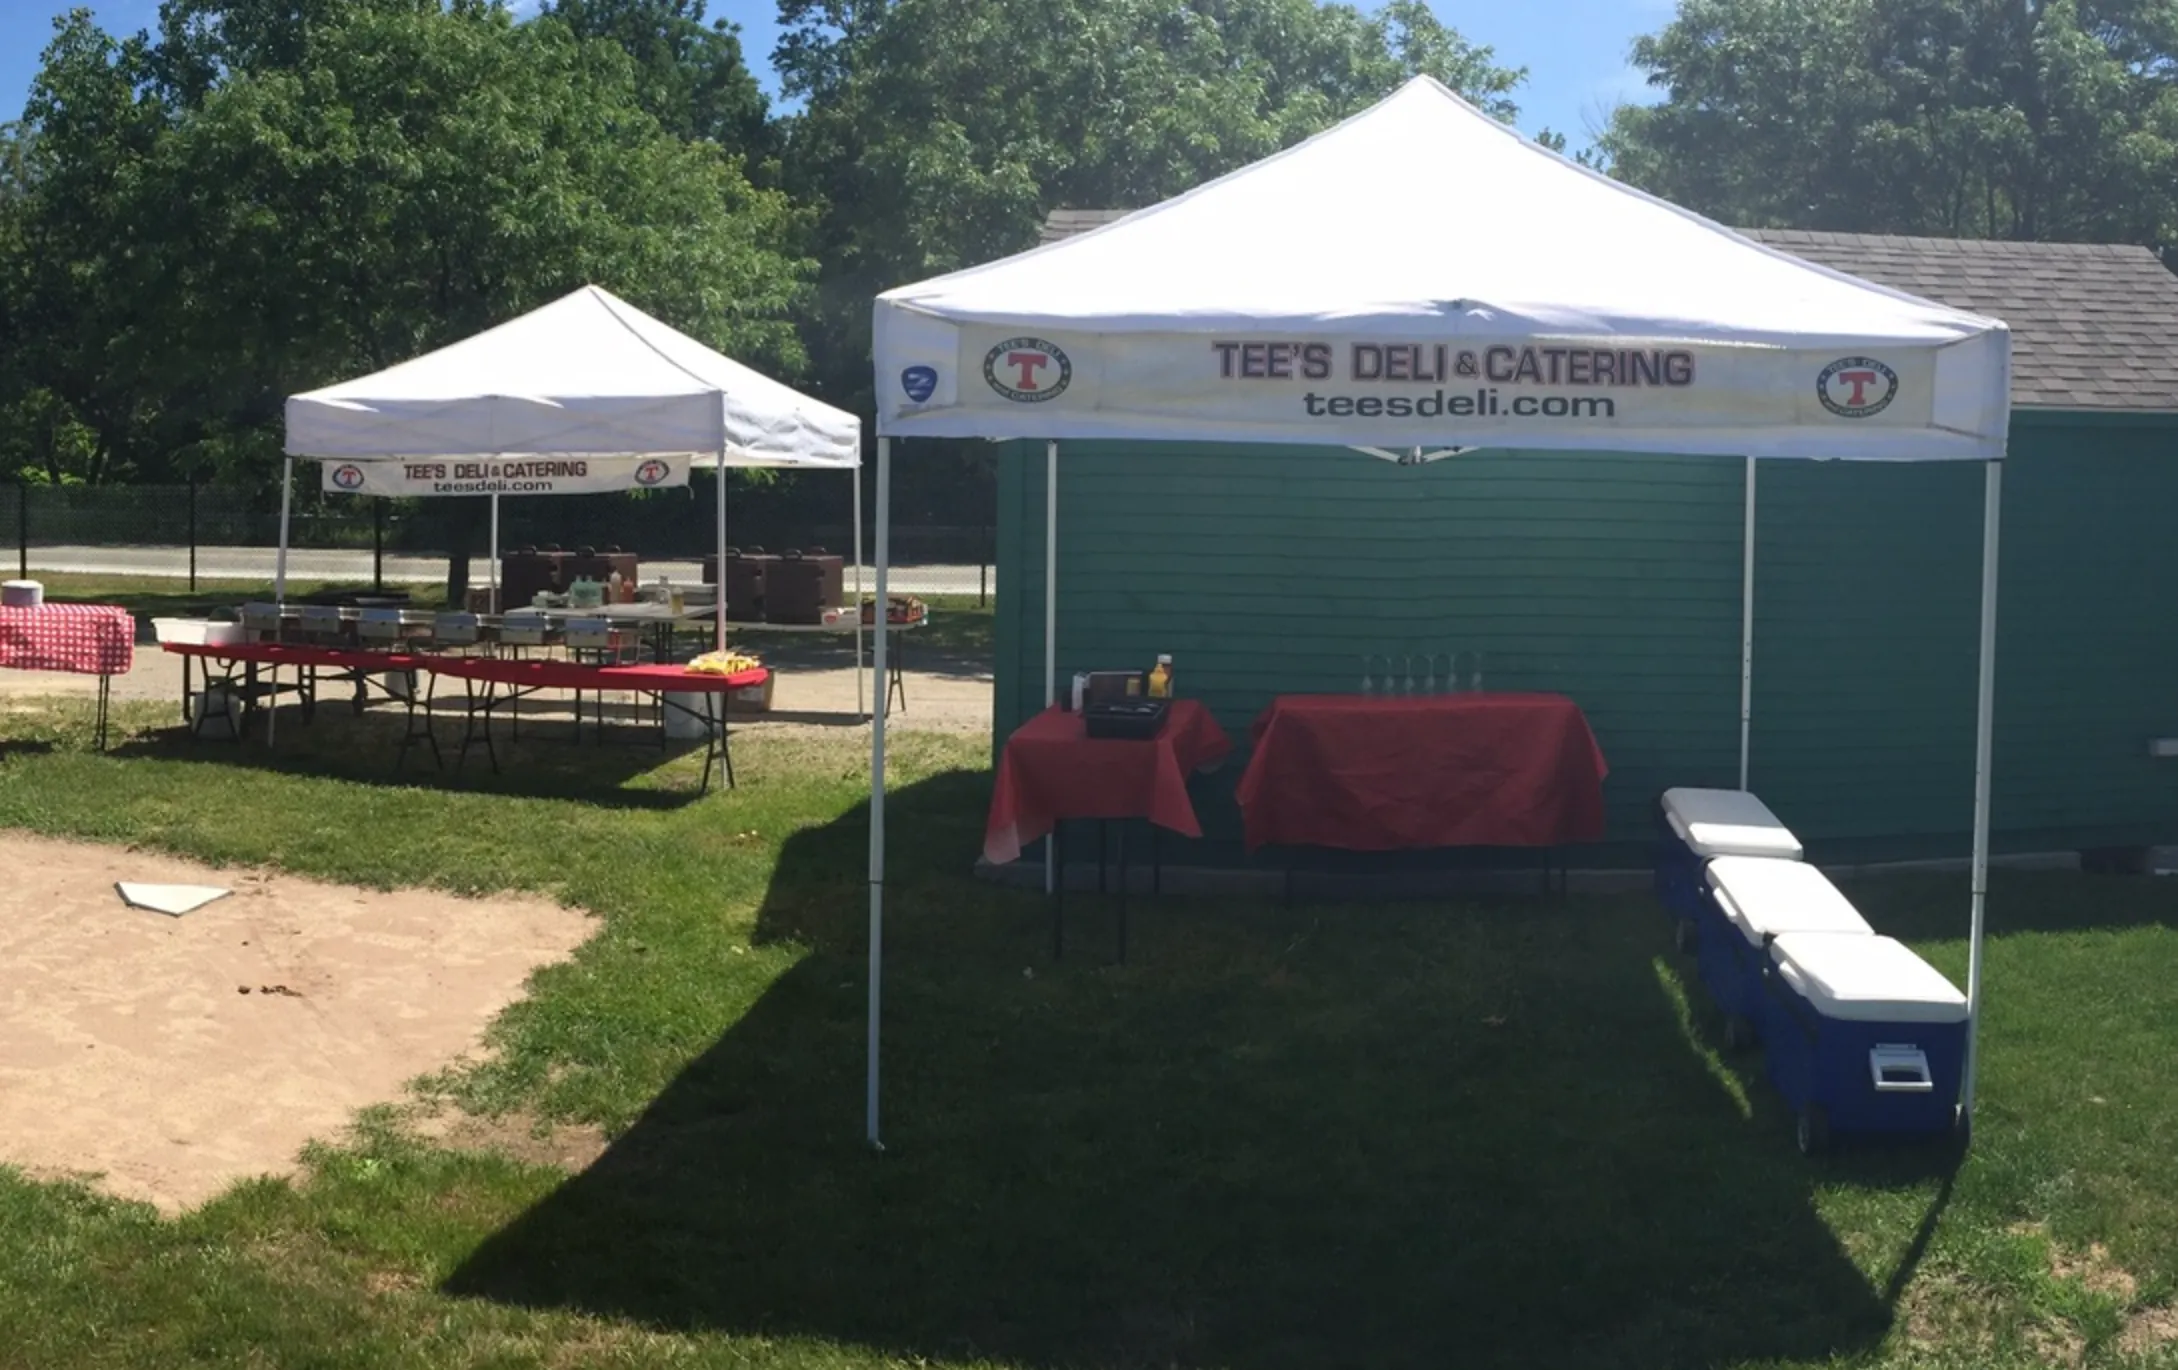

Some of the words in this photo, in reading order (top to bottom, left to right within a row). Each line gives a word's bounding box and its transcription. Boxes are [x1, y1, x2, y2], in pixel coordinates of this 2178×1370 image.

[1007, 351, 1048, 390] T
[1212, 341, 1333, 381] TEE'S
[1351, 342, 1448, 383] DELI
[1485, 343, 1696, 388] CATERING
[1303, 388, 1616, 418] teesdeli.com
[1838, 371, 1877, 405] T
[403, 463, 446, 480] TEE'S
[454, 463, 489, 480] DELI
[502, 461, 588, 479] CATERING
[433, 480, 553, 493] teesdeli.com
